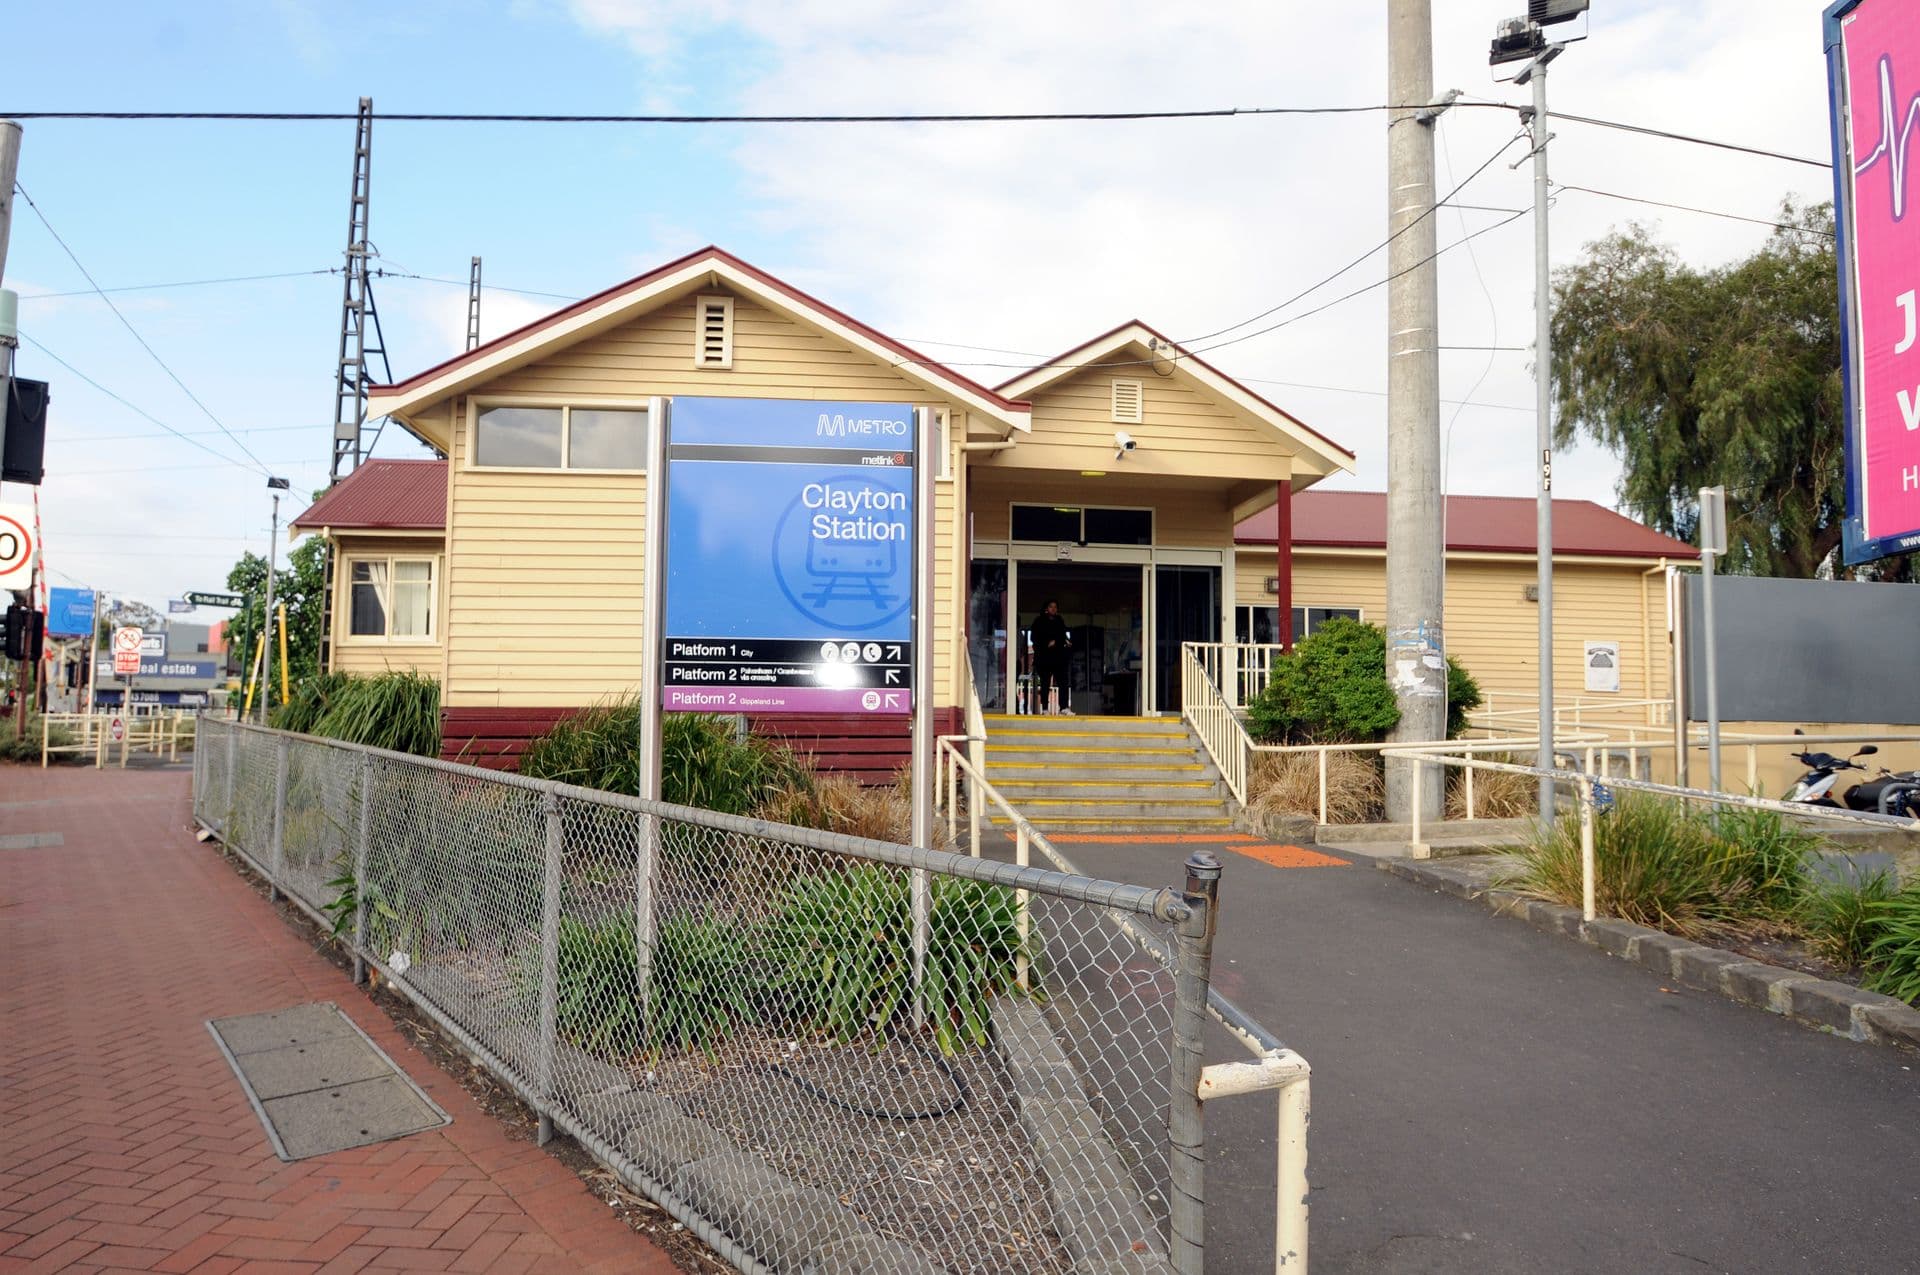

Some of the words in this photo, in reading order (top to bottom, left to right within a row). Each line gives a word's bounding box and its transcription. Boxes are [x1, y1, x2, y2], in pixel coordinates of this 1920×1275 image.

[848, 419, 907, 436] METRO
[861, 455, 895, 466] metlink
[802, 483, 906, 515] Clayton
[812, 514, 906, 540] Station
[118, 653, 138, 661] STOP
[673, 643, 726, 657] Platform
[729, 644, 736, 657] 1
[740, 649, 754, 658] City
[162, 663, 197, 674] estate
[672, 667, 725, 681] Platform
[728, 668, 737, 681] 2
[672, 692, 725, 705] Platform
[728, 692, 737, 705] 2
